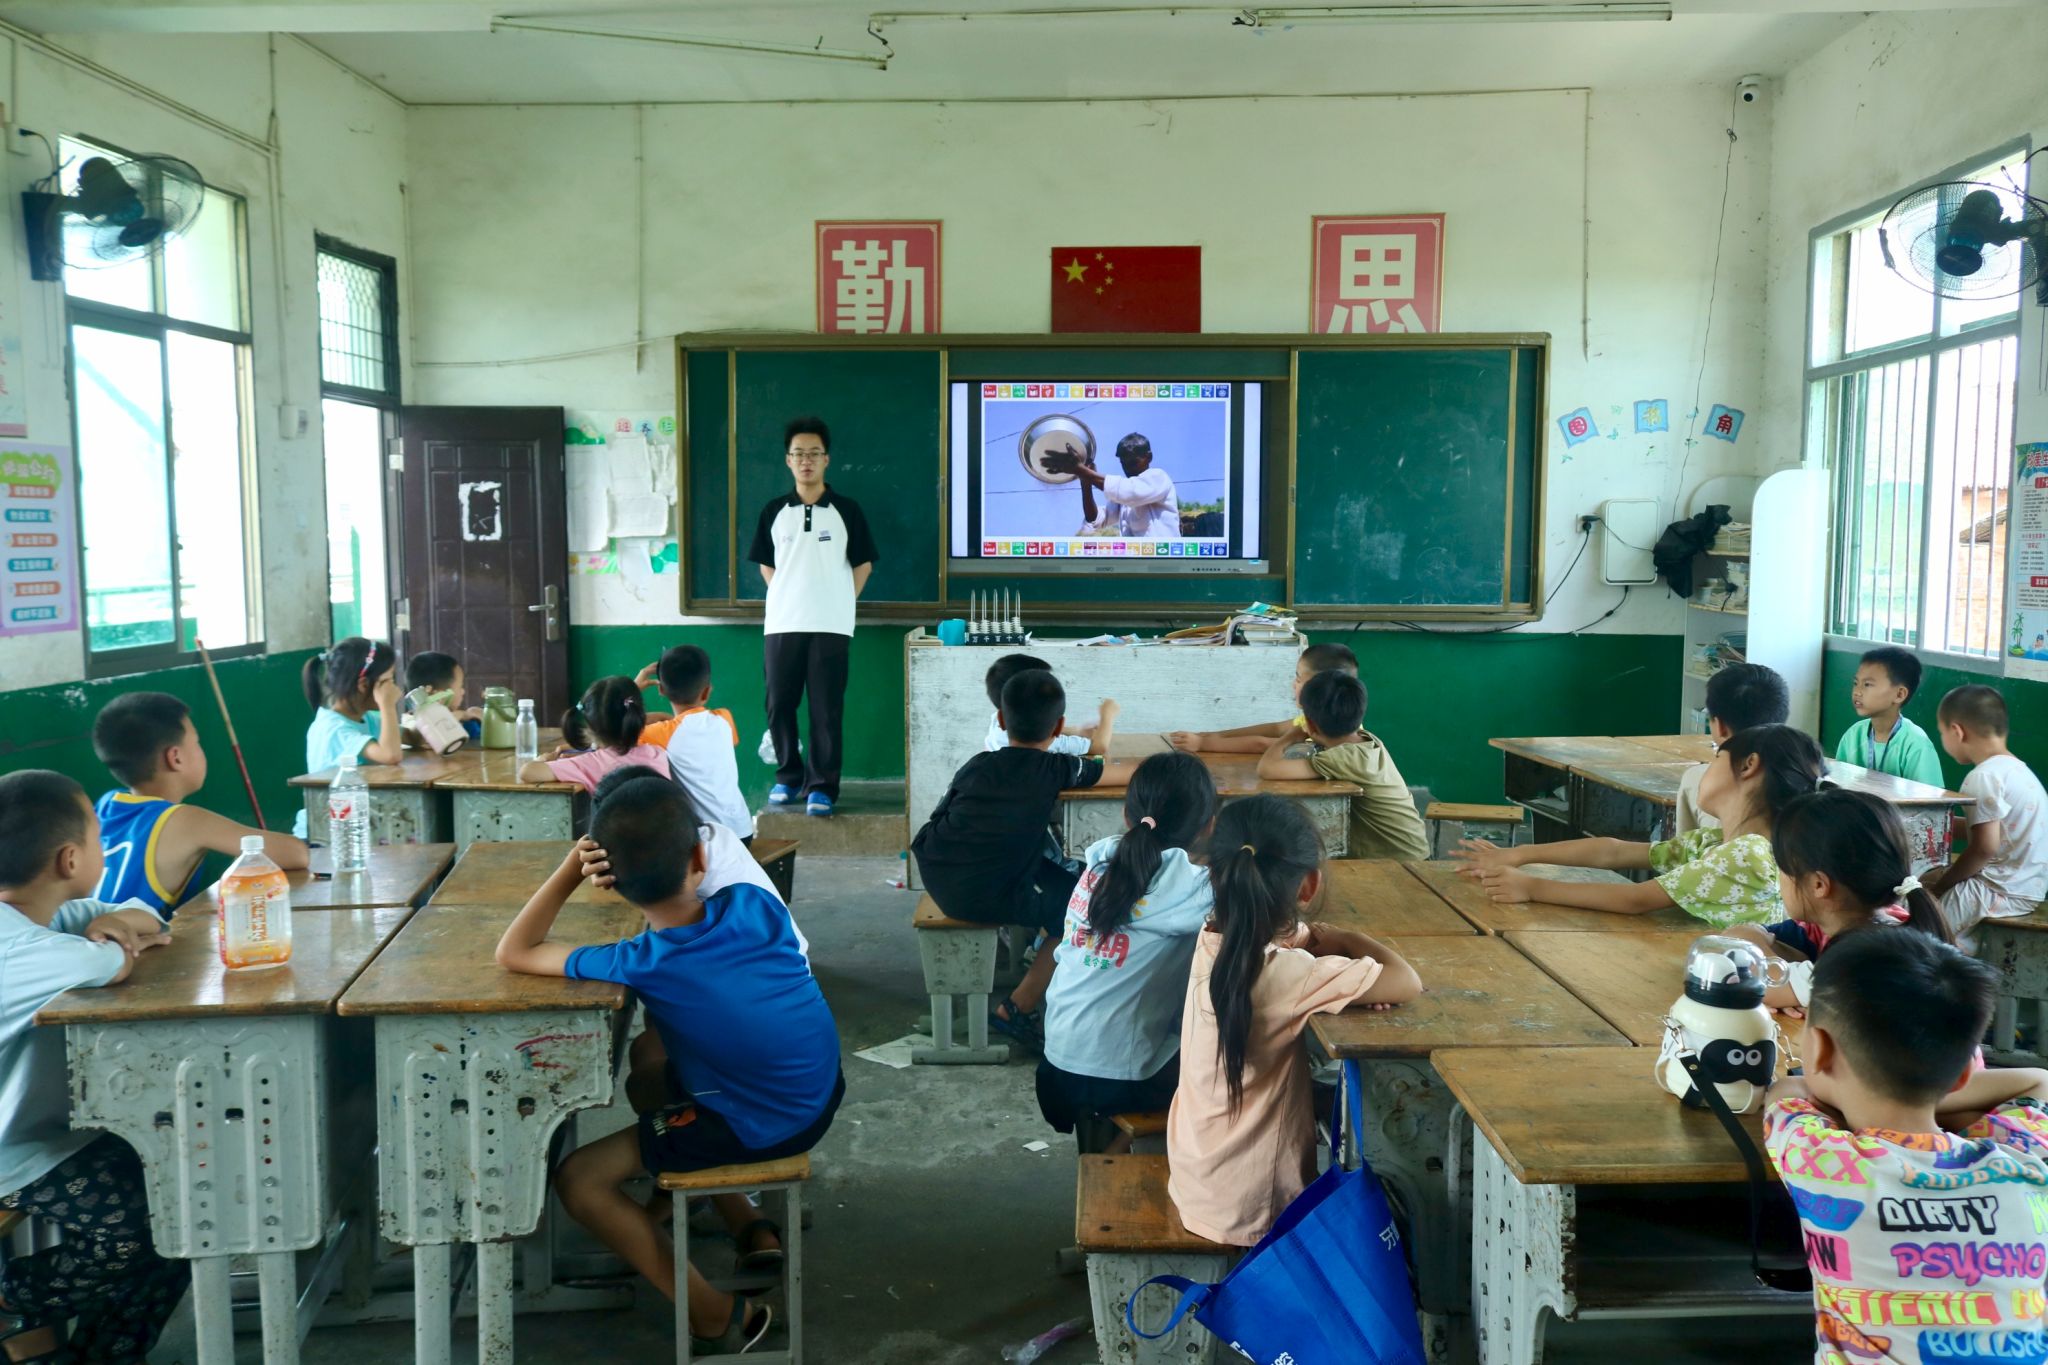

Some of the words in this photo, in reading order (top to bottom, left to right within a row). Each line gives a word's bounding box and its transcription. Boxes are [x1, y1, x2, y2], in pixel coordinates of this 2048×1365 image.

[832, 240, 925, 334] 勤
[1327, 234, 1427, 333] 思
[1567, 405, 1733, 437] 图书角
[1878, 1195, 1999, 1235] DIRTY
[1890, 1241, 2046, 1286] PSYCHO
